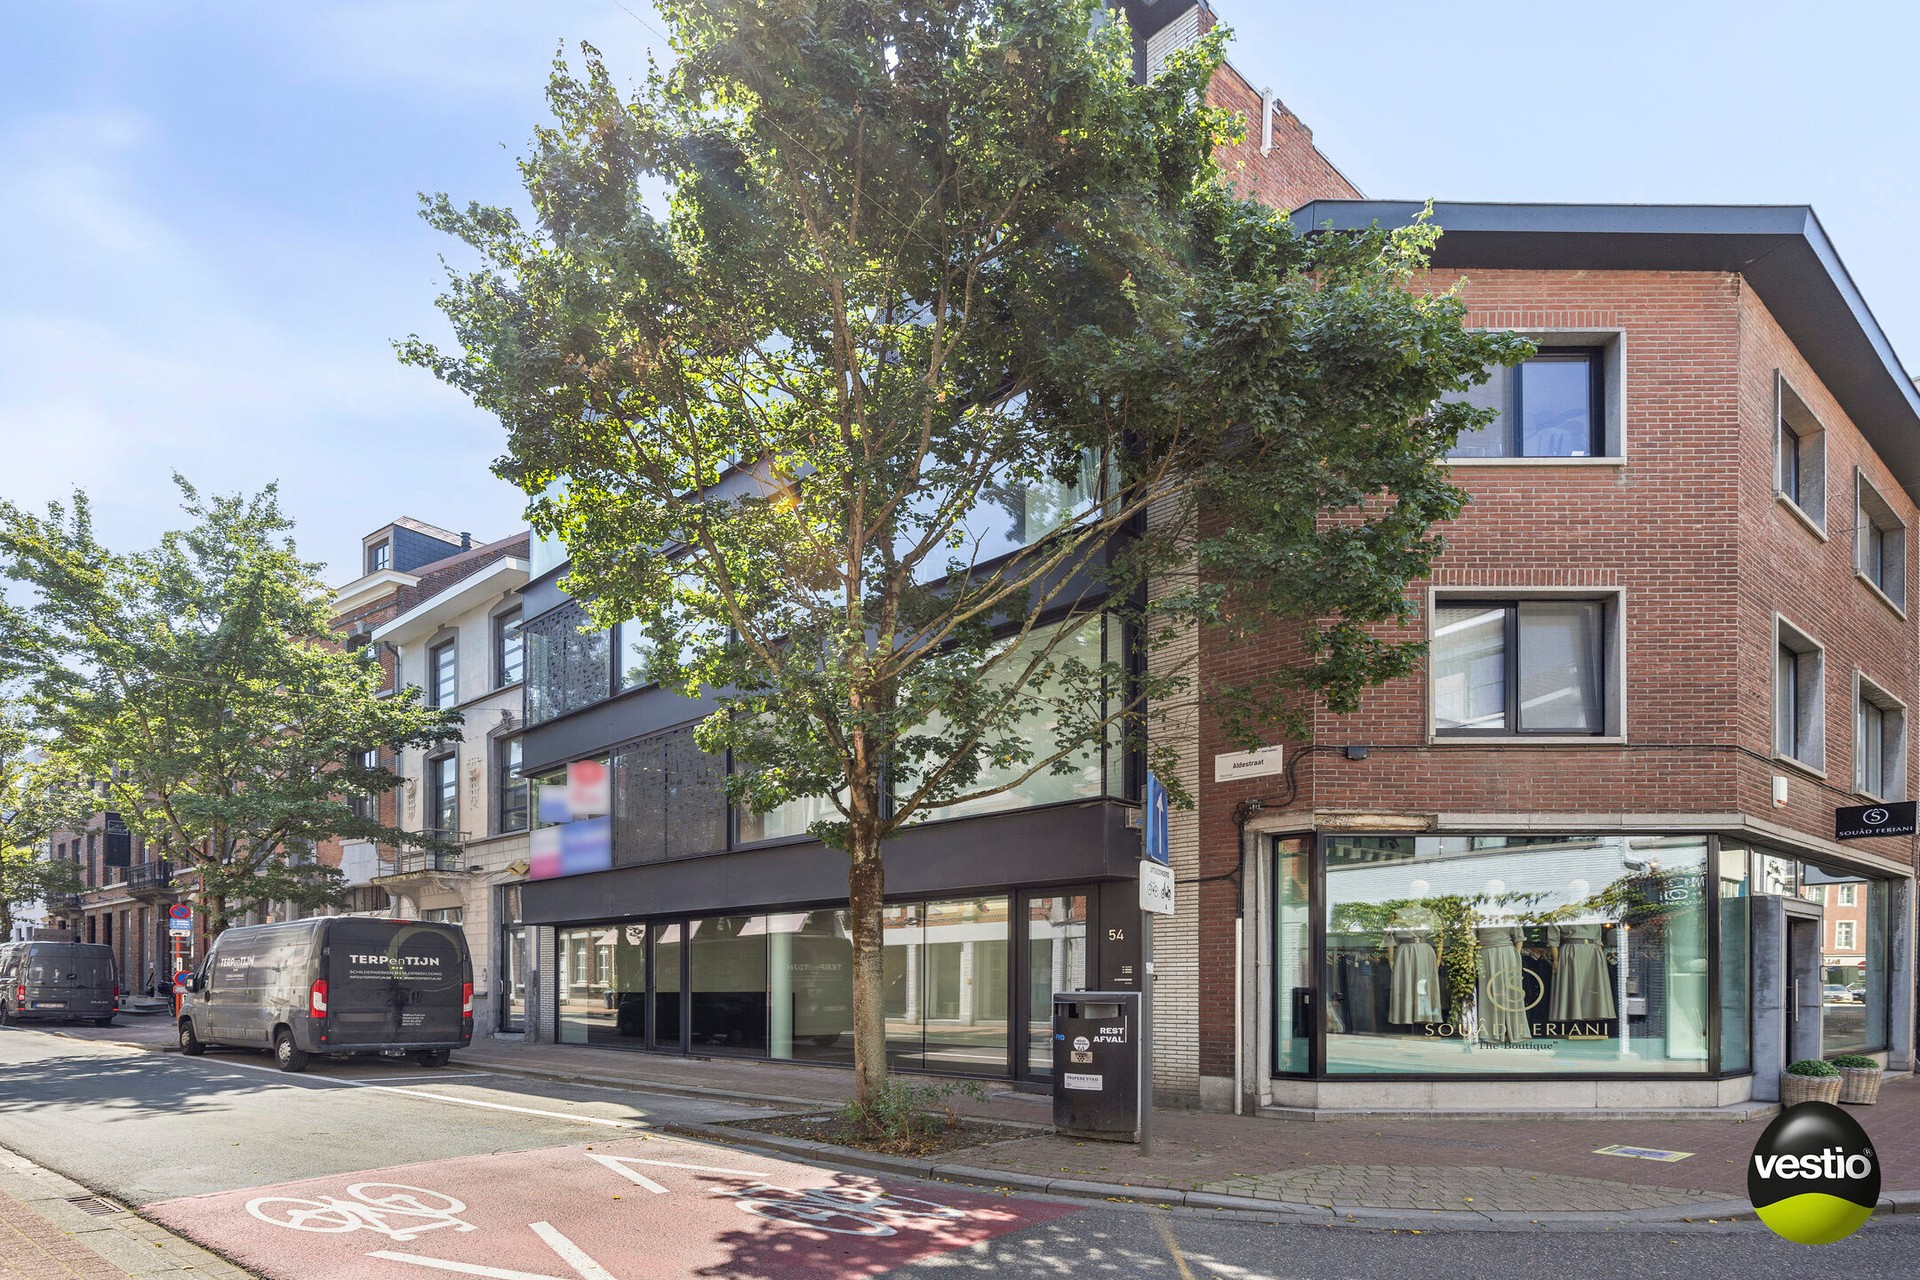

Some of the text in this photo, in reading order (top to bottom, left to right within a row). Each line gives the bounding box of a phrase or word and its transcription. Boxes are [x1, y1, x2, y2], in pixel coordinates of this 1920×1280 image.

[1233, 759, 1264, 769] Aldestraat
[1876, 826, 1913, 834] FERIANI
[1109, 929, 1124, 941] 54
[349, 954, 440, 966] TERPenTIJN
[1519, 1023, 1609, 1036] FERIANI
[1092, 1035, 1124, 1043] AFVAL
